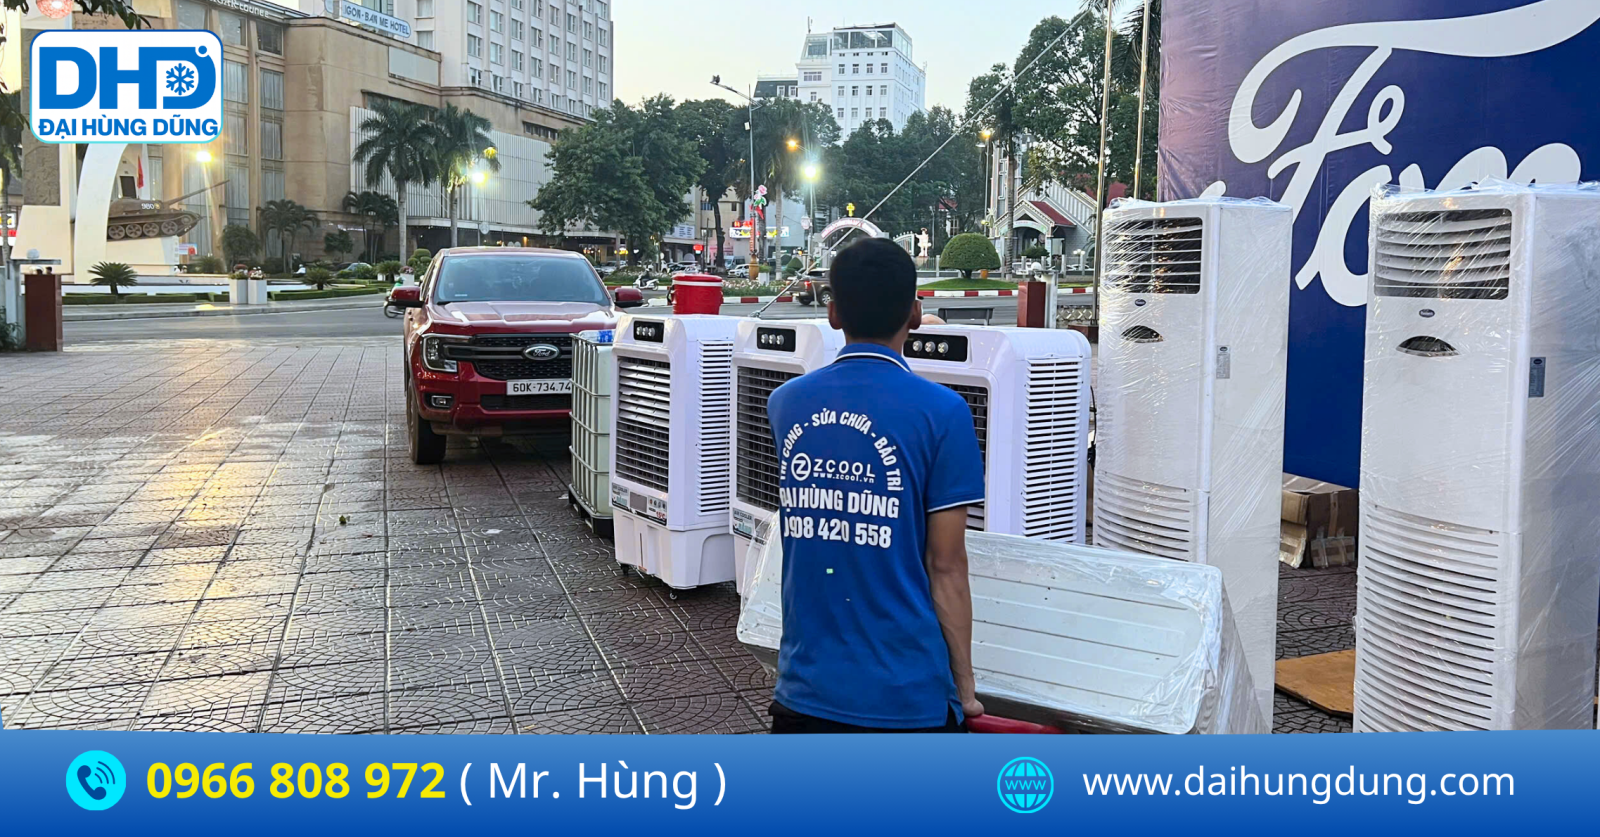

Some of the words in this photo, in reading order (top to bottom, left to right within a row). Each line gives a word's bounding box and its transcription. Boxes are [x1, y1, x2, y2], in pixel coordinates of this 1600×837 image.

[390, 20, 410, 35] HOTEL
[532, 348, 551, 357] Ford
[513, 382, 571, 393] 60K-734.74
[782, 423, 803, 458] CÔNG
[811, 407, 837, 427] SỬA
[839, 411, 873, 435] CHỮA
[873, 436, 897, 466] BẢO
[885, 468, 904, 491] TRÌ
[813, 459, 876, 477] ZCOOL
[813, 472, 875, 484] www.zcool.vn
[798, 483, 844, 511] HÙNG
[847, 489, 900, 518] DŨNG
[817, 518, 850, 542] 420
[854, 522, 892, 549] 558
